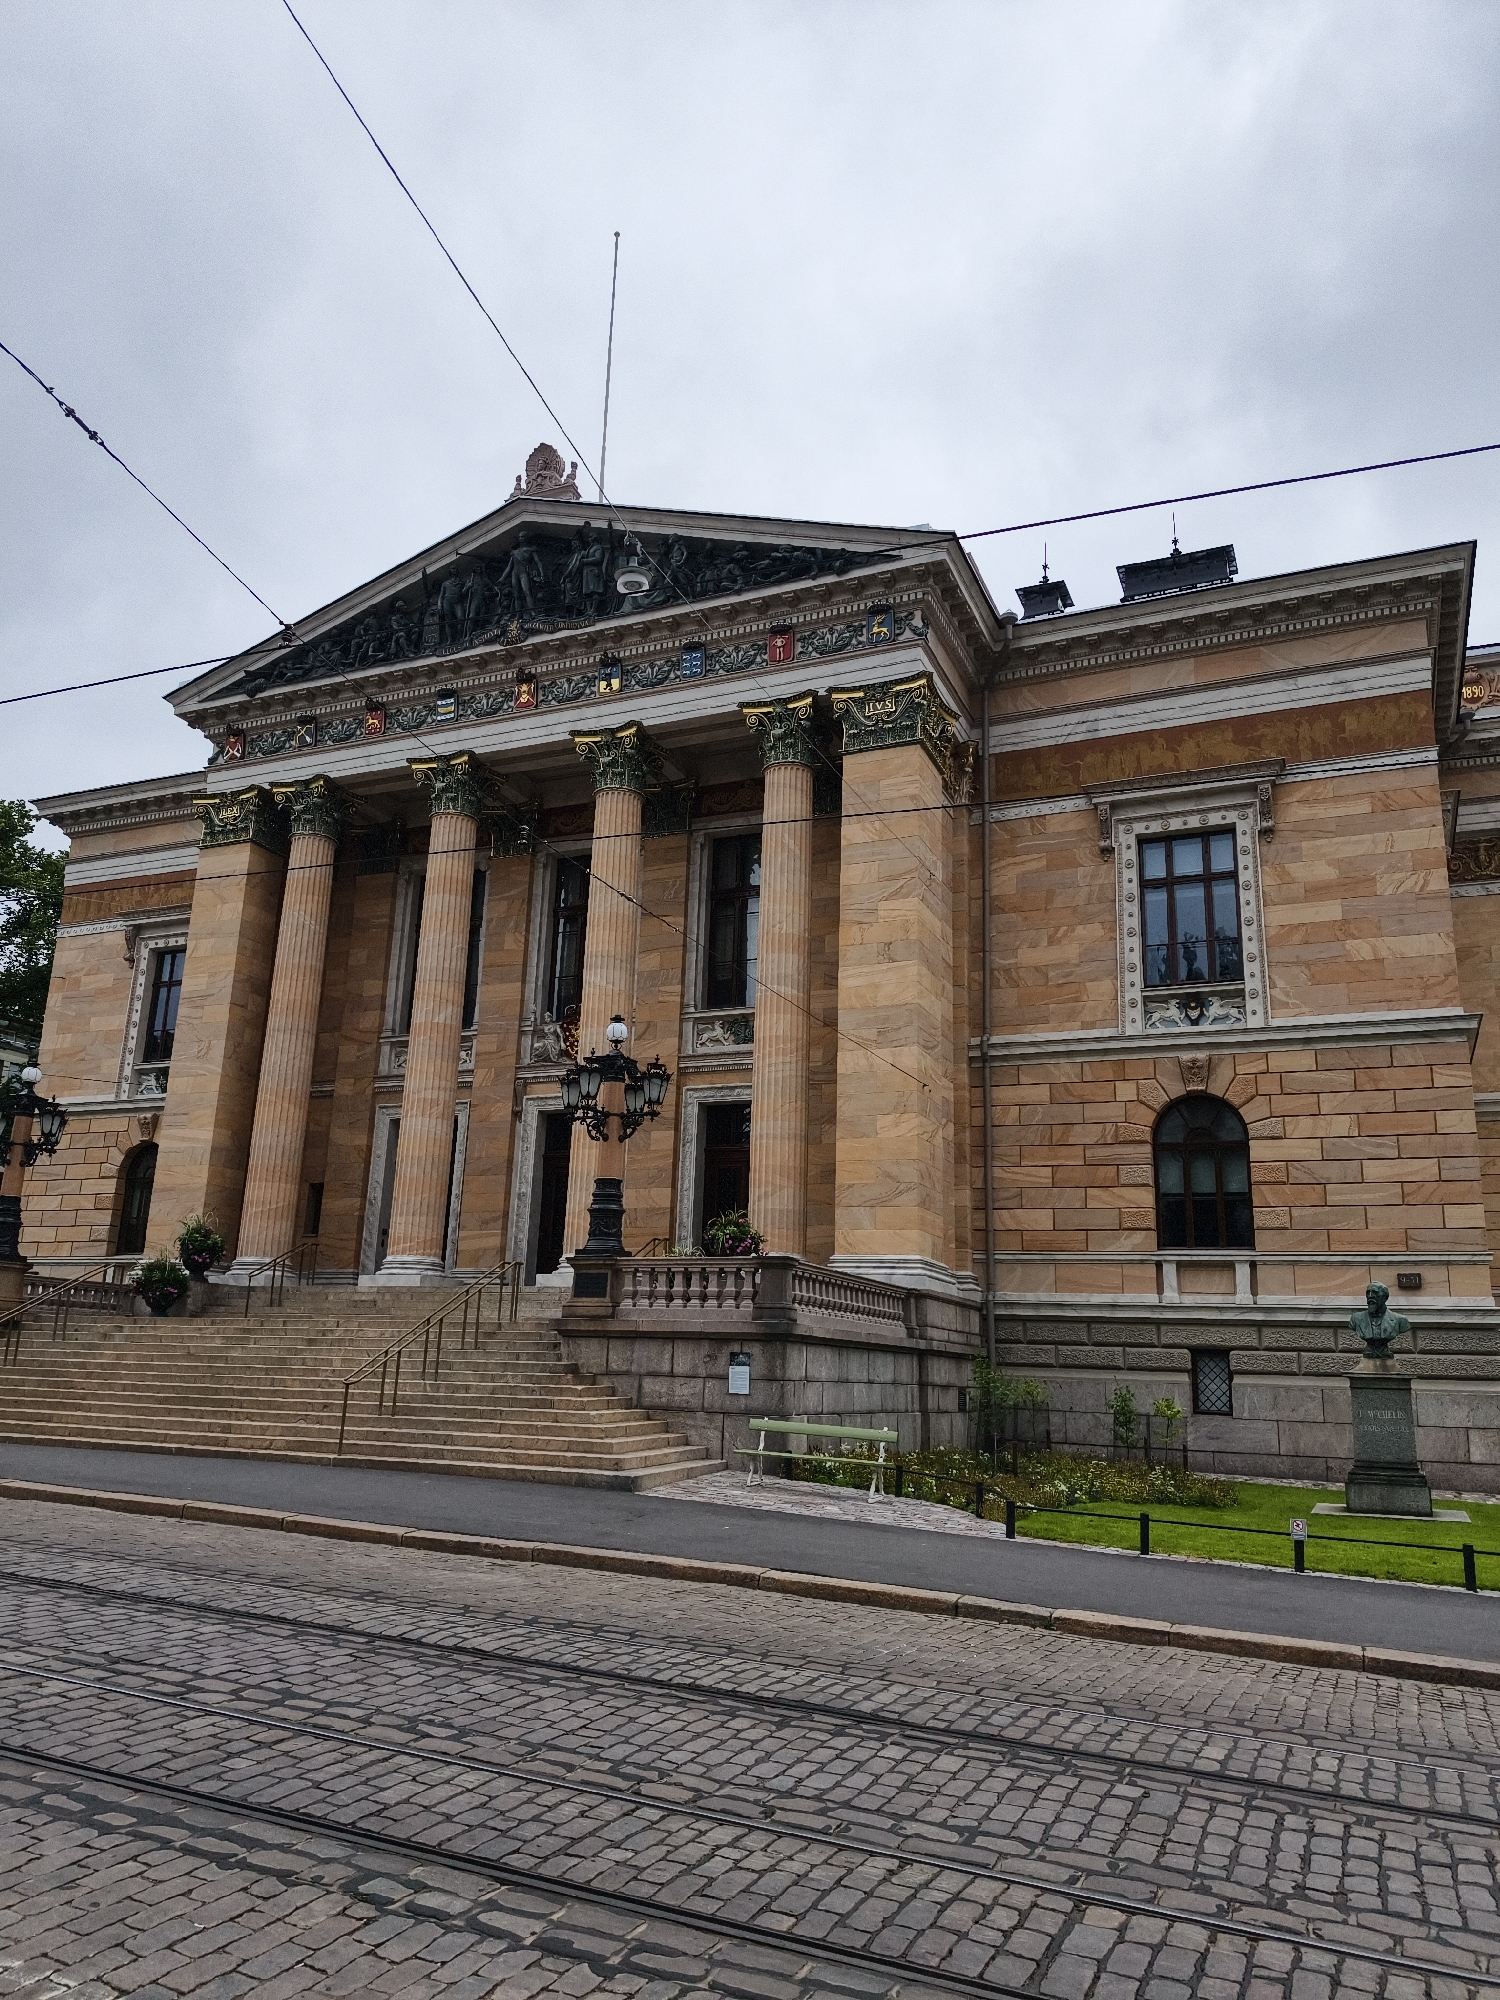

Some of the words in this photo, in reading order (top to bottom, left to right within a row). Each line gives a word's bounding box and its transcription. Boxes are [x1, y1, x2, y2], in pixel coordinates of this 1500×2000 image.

[1462, 685, 1484, 699] 1890
[869, 699, 892, 712] IVS
[222, 805, 238, 816] LEX
